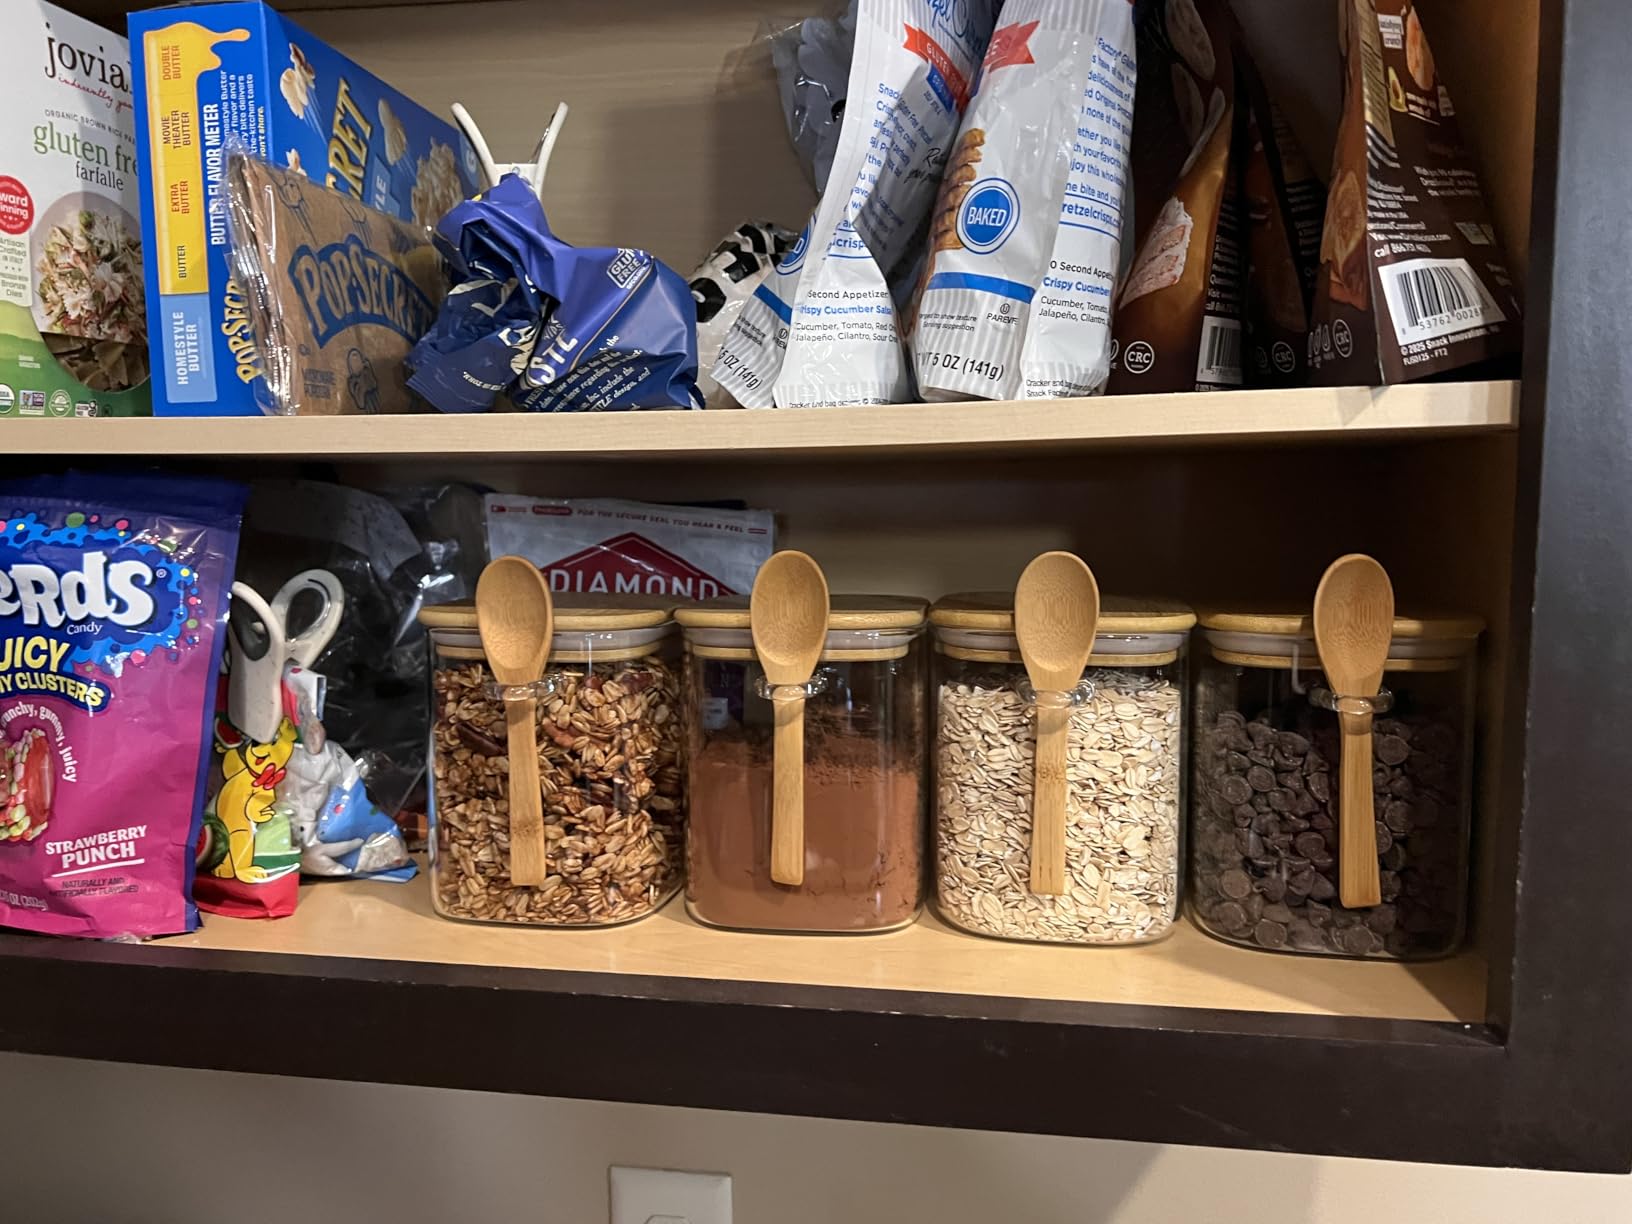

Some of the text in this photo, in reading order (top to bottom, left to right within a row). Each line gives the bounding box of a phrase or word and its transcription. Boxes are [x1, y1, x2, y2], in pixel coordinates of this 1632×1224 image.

[45, 22, 132, 94] jovia
[45, 109, 78, 122] ORGANIC
[80, 116, 107, 131] BROWN
[182, 112, 190, 146] BUTTER
[203, 103, 220, 147] METER
[230, 103, 239, 132] flavor
[239, 113, 247, 132] bite
[34, 121, 110, 167] gluten
[75, 160, 124, 191] farfalle
[206, 148, 222, 196] FLAVOR
[171, 183, 179, 215] EXTRA
[181, 180, 189, 215] BUTTER
[1080, 183, 1096, 197] bite
[1097, 190, 1109, 201] and
[966, 206, 1008, 228] BAKED
[178, 244, 186, 280] BUTTER
[616, 258, 641, 282] FREE
[1060, 261, 1092, 275] Second
[808, 289, 840, 299] Second
[1043, 277, 1073, 291] Crispy
[824, 305, 874, 314] Cucumber
[1039, 308, 1078, 322] Jalapeño,
[1040, 295, 1084, 310] Cucumber,
[838, 332, 870, 342] Cilantro,
[873, 333, 887, 341] Sour
[841, 321, 874, 332] Tomato,
[173, 311, 188, 385] HOMESTYLE
[186, 323, 201, 373] BUTTER
[1128, 351, 1151, 363] CRC
[581, 366, 611, 389] regarding
[600, 375, 624, 394] include
[623, 366, 635, 376] the
[638, 367, 651, 382] and
[723, 354, 740, 370] OZ
[732, 364, 763, 391] (141g)
[932, 353, 1004, 382] 5 OZ (141g)
[577, 509, 595, 517] FOR
[615, 512, 647, 522] SECURE
[672, 518, 690, 527] YOU
[692, 520, 715, 530] HEAR
[725, 523, 744, 533] FEEL
[551, 568, 719, 600] DIAMOND
[66, 621, 103, 636] Candy
[15, 672, 105, 708] CLUSTERS
[39, 706, 66, 747] gummy,
[45, 824, 147, 856] STRAWBERRY
[61, 841, 136, 870] PUNCH
[62, 879, 106, 889] NATURALLY
